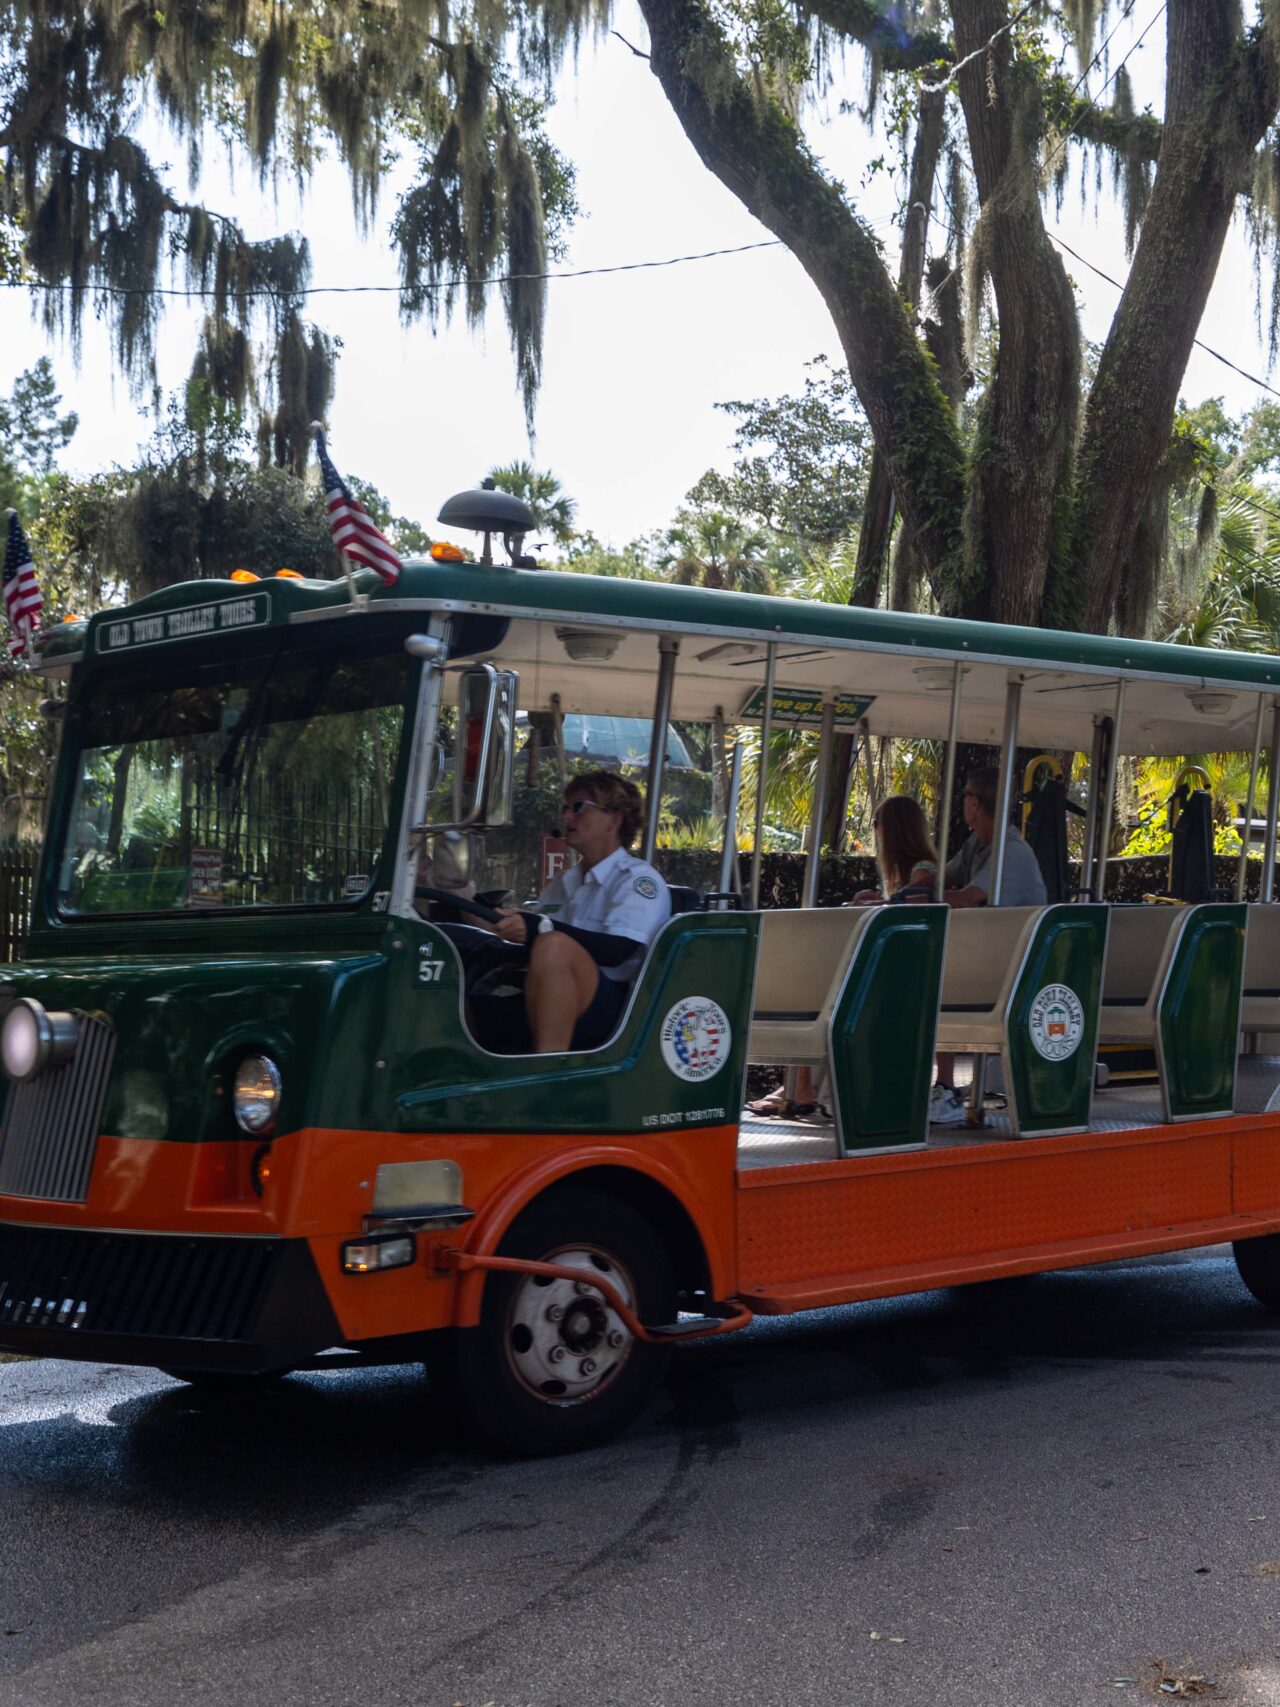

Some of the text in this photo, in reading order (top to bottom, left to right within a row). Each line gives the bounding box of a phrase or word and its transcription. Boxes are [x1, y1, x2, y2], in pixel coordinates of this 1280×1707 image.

[372, 891, 391, 912] 57
[419, 961, 445, 982] 57
[663, 1002, 690, 1041] Historic
[1032, 1009, 1043, 1028] OLD
[641, 1114, 659, 1126] US
[660, 1112, 683, 1125] DOT
